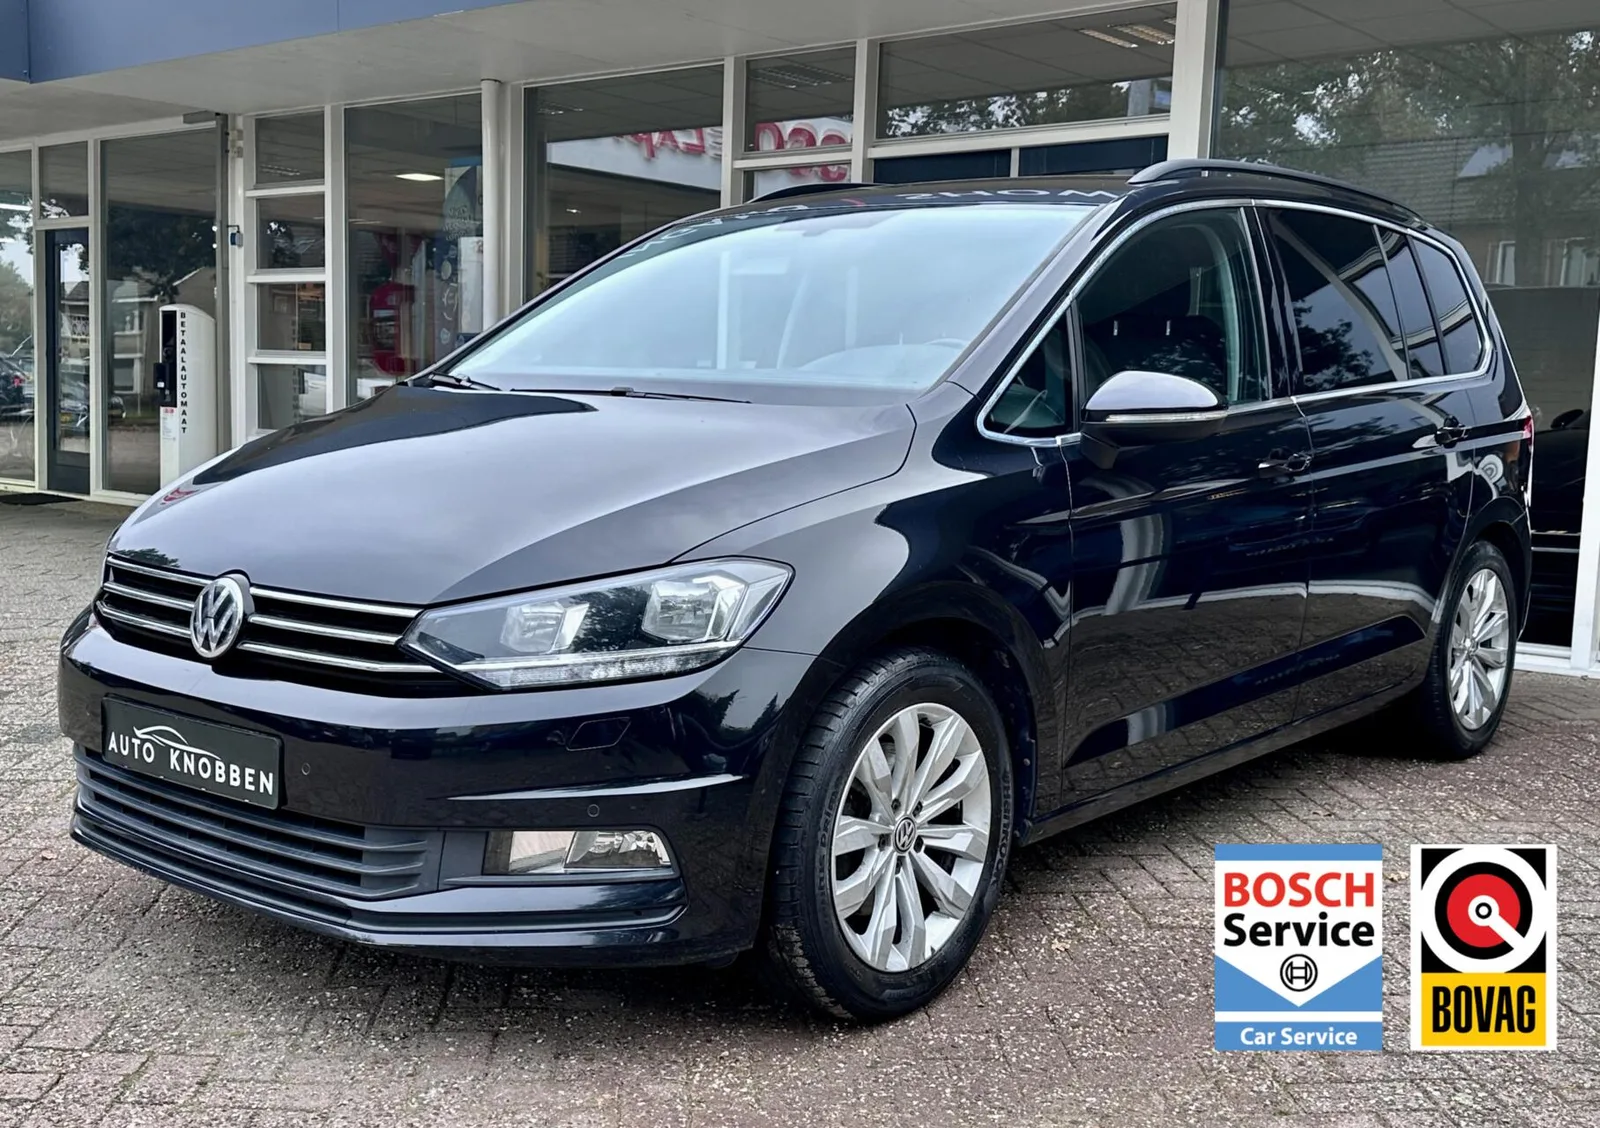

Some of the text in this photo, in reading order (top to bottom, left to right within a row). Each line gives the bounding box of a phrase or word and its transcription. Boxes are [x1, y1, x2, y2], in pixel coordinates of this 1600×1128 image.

[179, 311, 189, 434] BETAALAUTOMAAT
[108, 731, 274, 796] AUTO KNOBBEN
